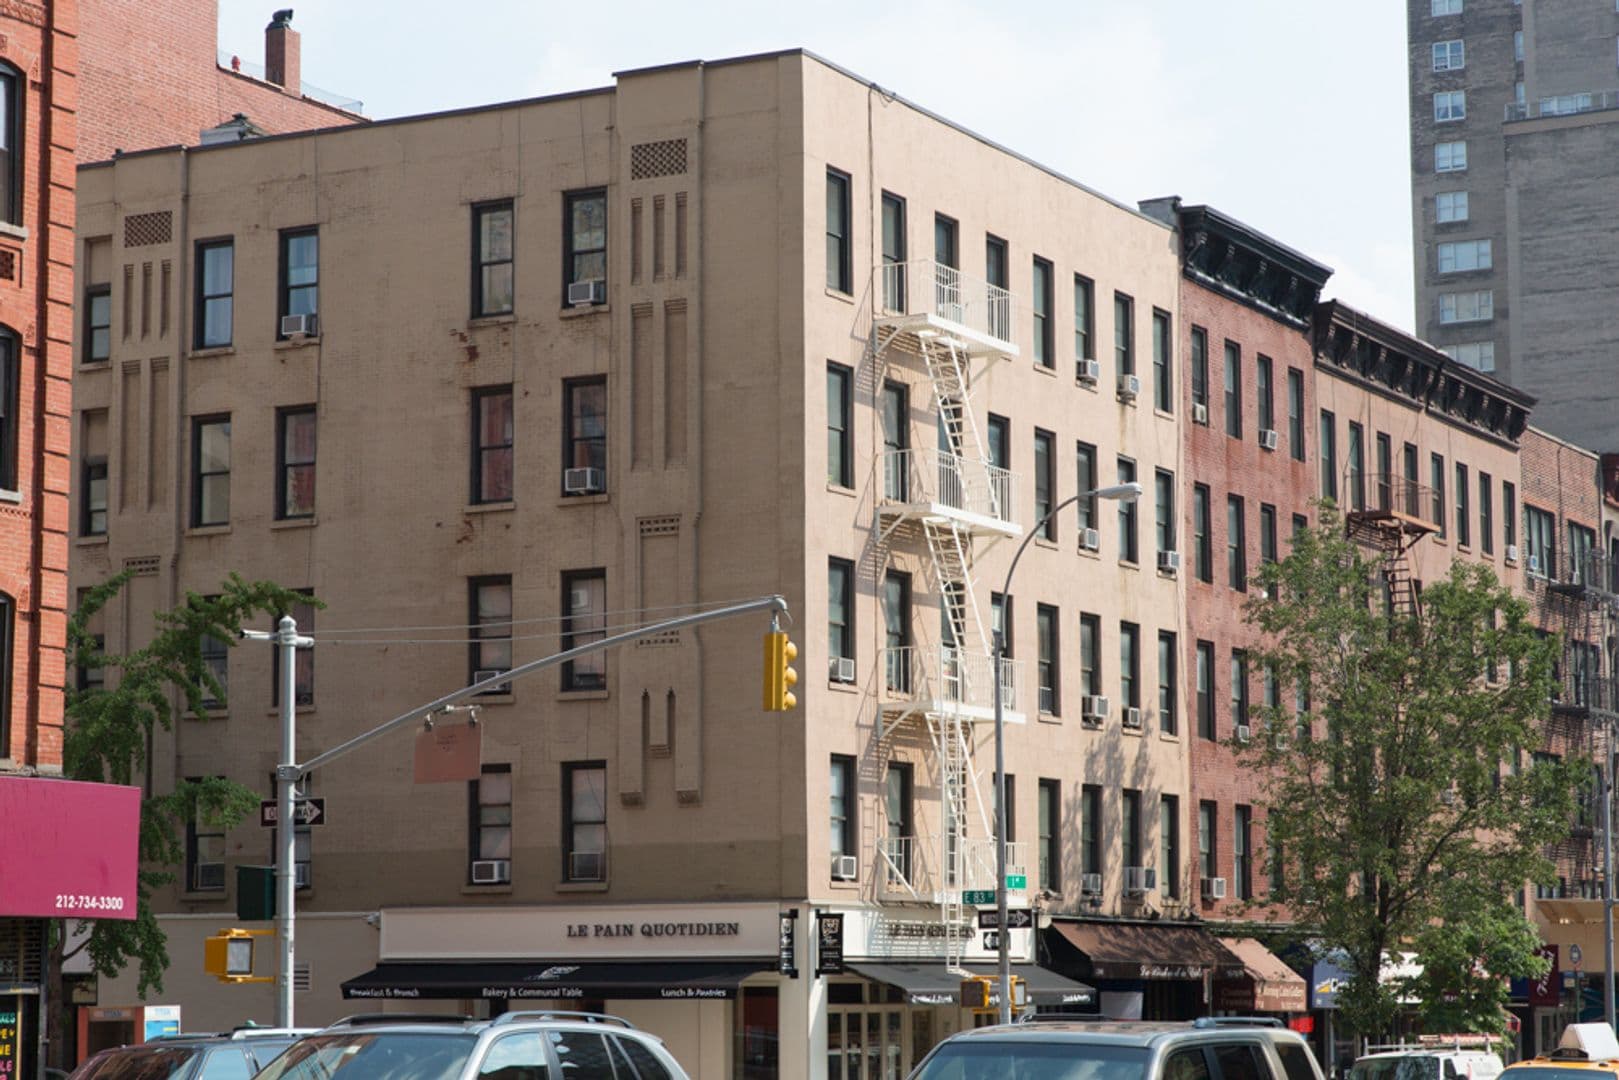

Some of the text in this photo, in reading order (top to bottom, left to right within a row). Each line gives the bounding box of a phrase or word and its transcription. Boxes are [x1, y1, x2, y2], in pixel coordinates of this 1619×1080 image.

[55, 894, 124, 911] 212-734-3300
[567, 922, 740, 938] LE PAIN QUOTIDIEN
[482, 988, 584, 999] Bakery & Communal Table
[660, 988, 686, 998] Lunch
